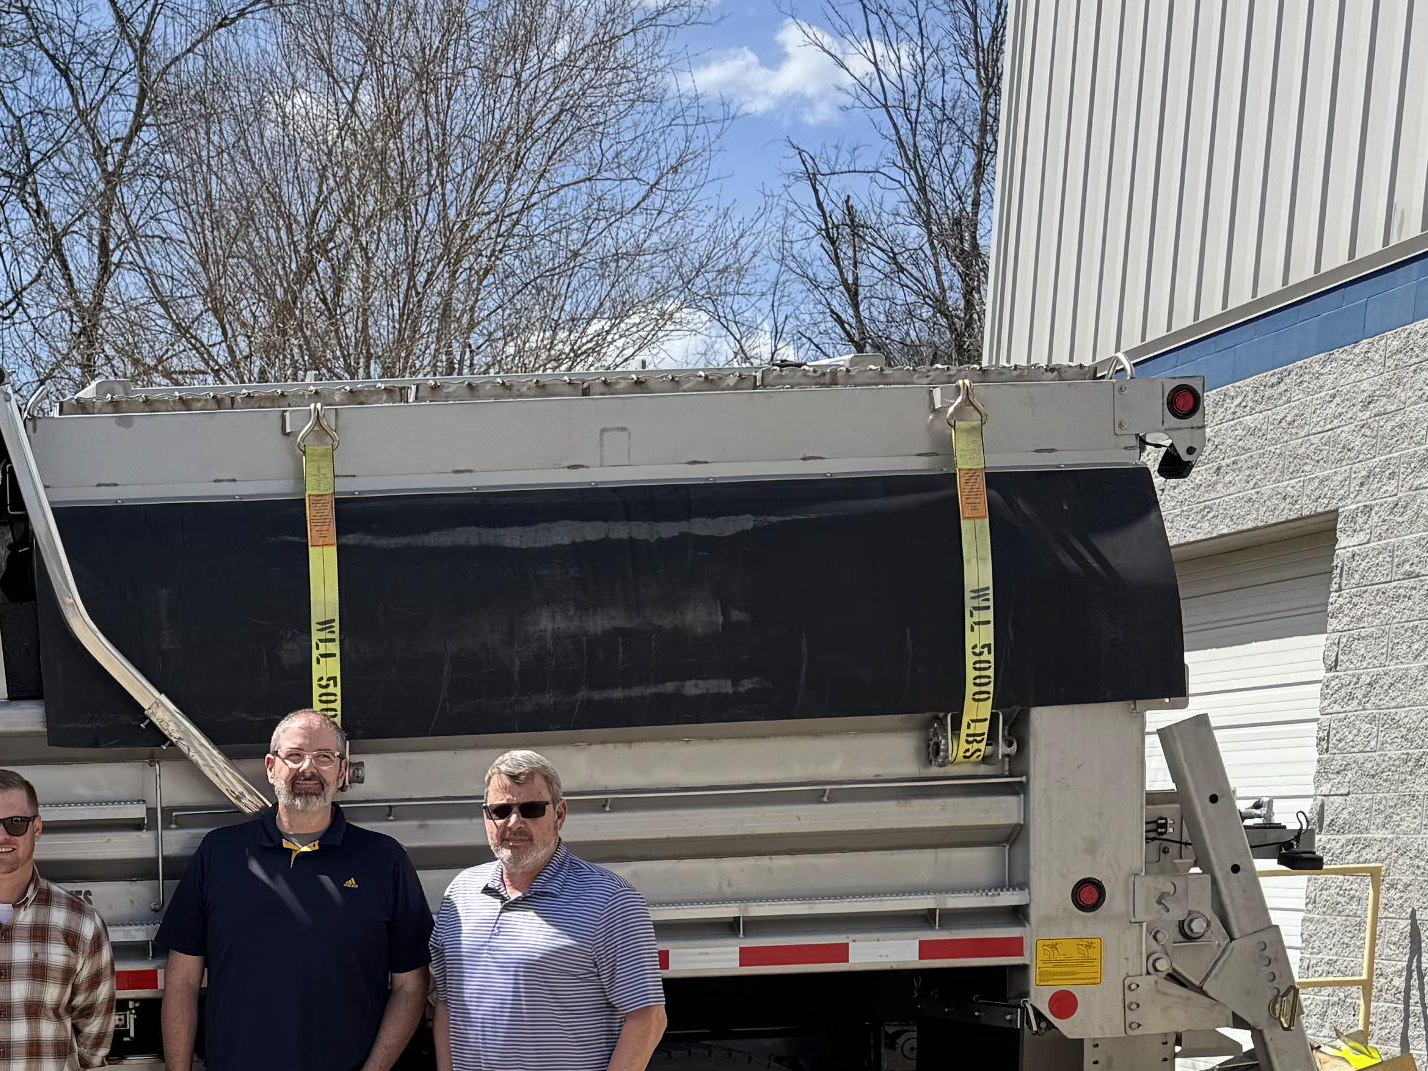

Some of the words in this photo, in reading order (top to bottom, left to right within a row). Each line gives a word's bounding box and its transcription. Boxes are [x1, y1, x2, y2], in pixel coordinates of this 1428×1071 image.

[969, 586, 991, 632] WLL
[315, 618, 336, 665] WLL
[971, 643, 992, 702] 5000
[962, 717, 988, 760] LBS
